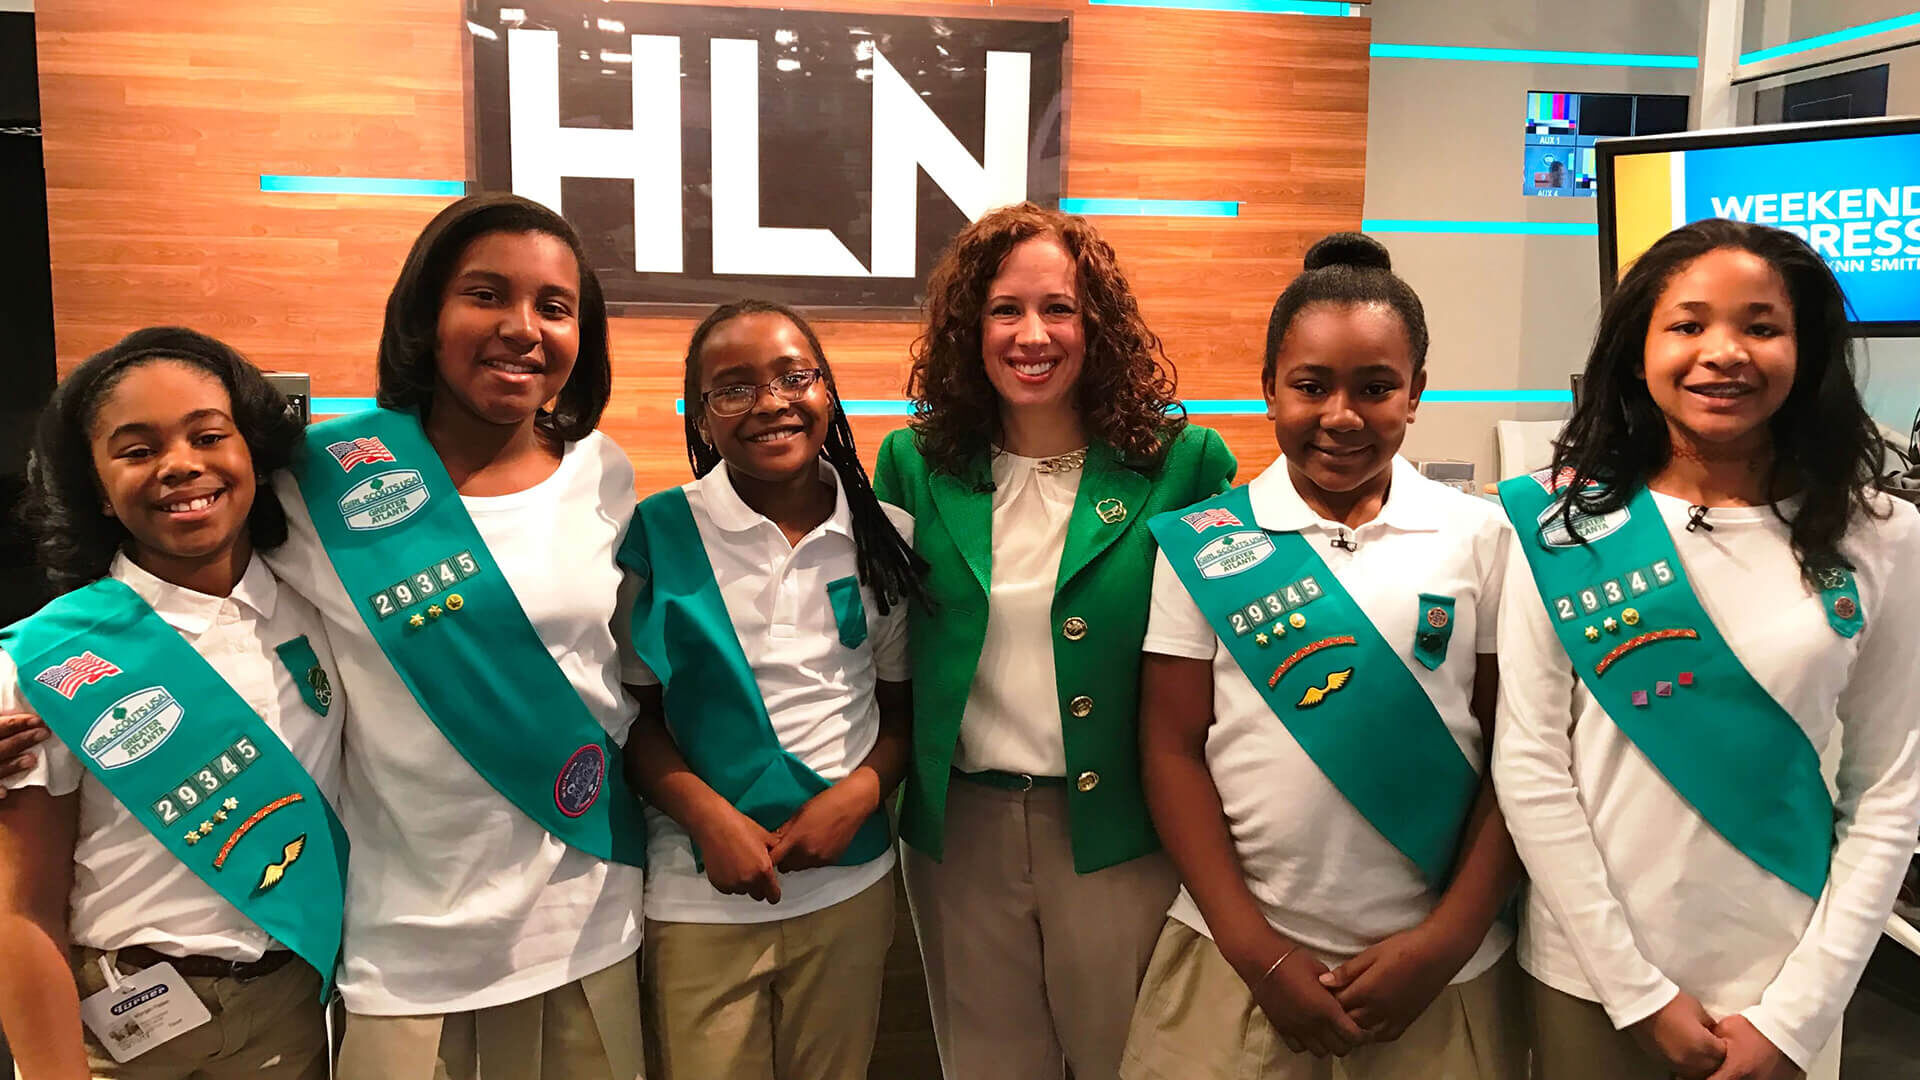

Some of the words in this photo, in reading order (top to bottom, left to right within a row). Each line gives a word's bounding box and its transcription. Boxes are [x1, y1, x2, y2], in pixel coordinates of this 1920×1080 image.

[508, 29, 1031, 278] HLN
[1540, 136, 1555, 145] AUX
[1556, 136, 1561, 145] 1
[1537, 189, 1553, 197] AUX
[1711, 185, 1920, 223] WEEKEND
[343, 497, 364, 510] GIRL
[363, 483, 400, 503] SCOUTS
[400, 476, 419, 489] USA
[368, 497, 408, 517] GREATER
[371, 504, 411, 525] ATLANTA
[1220, 550, 1255, 567] GREATER
[1223, 555, 1257, 573] ATLANTA
[376, 553, 475, 615] 29345
[1558, 561, 1671, 619] 29345
[1232, 578, 1319, 633] 29345
[88, 734, 113, 752] GIRL
[109, 706, 148, 737] SCOUTS
[145, 693, 167, 709] USA
[120, 718, 162, 751] GREATER
[127, 725, 167, 758] ATLANTA
[157, 738, 256, 821] 29345
